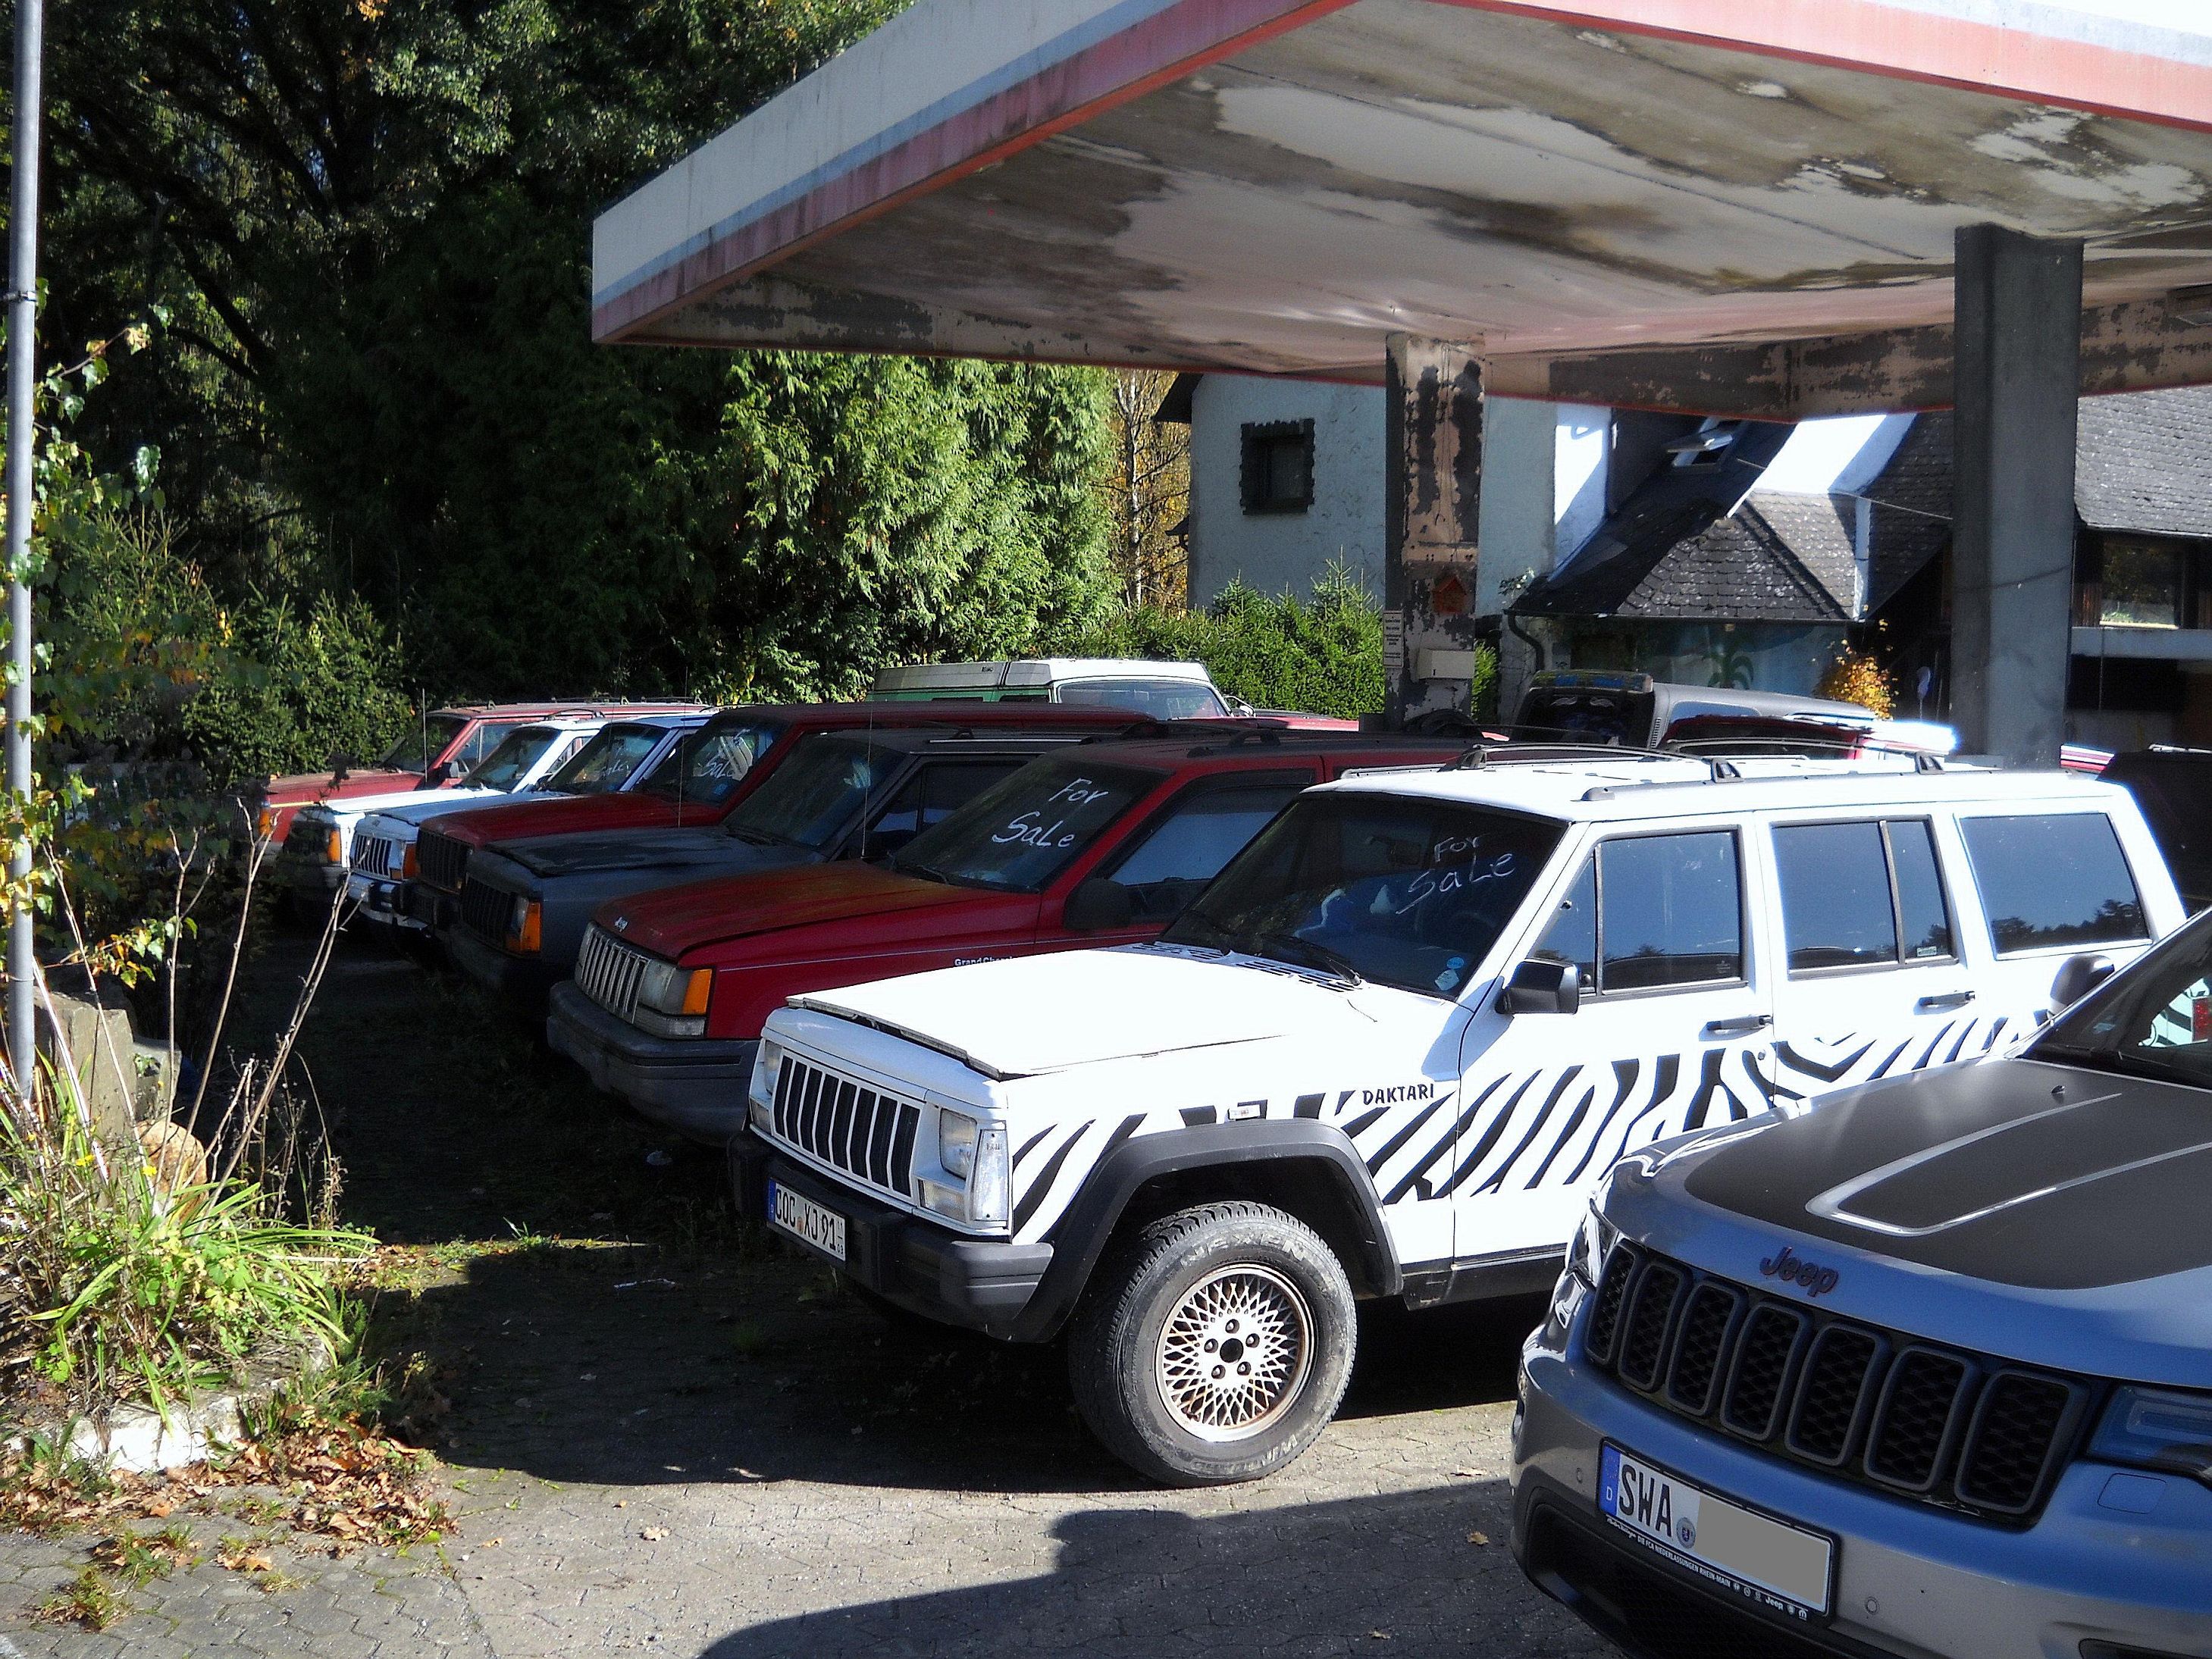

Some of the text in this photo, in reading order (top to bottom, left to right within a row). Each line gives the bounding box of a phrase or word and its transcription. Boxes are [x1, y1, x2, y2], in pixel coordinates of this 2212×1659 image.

[1048, 777, 1109, 804] For
[1434, 834, 1480, 862] For
[955, 957, 982, 966] Grand
[1362, 1083, 1434, 1106] DAKTARI
[775, 1188, 796, 1227] COC
[804, 1204, 818, 1240] XJ
[821, 1214, 836, 1251] 91
[1759, 1246, 1839, 1297] Jeep
[1606, 1485, 1612, 1501] D
[1619, 1464, 1672, 1537] SWA
[1765, 1596, 1784, 1611] Jeep
